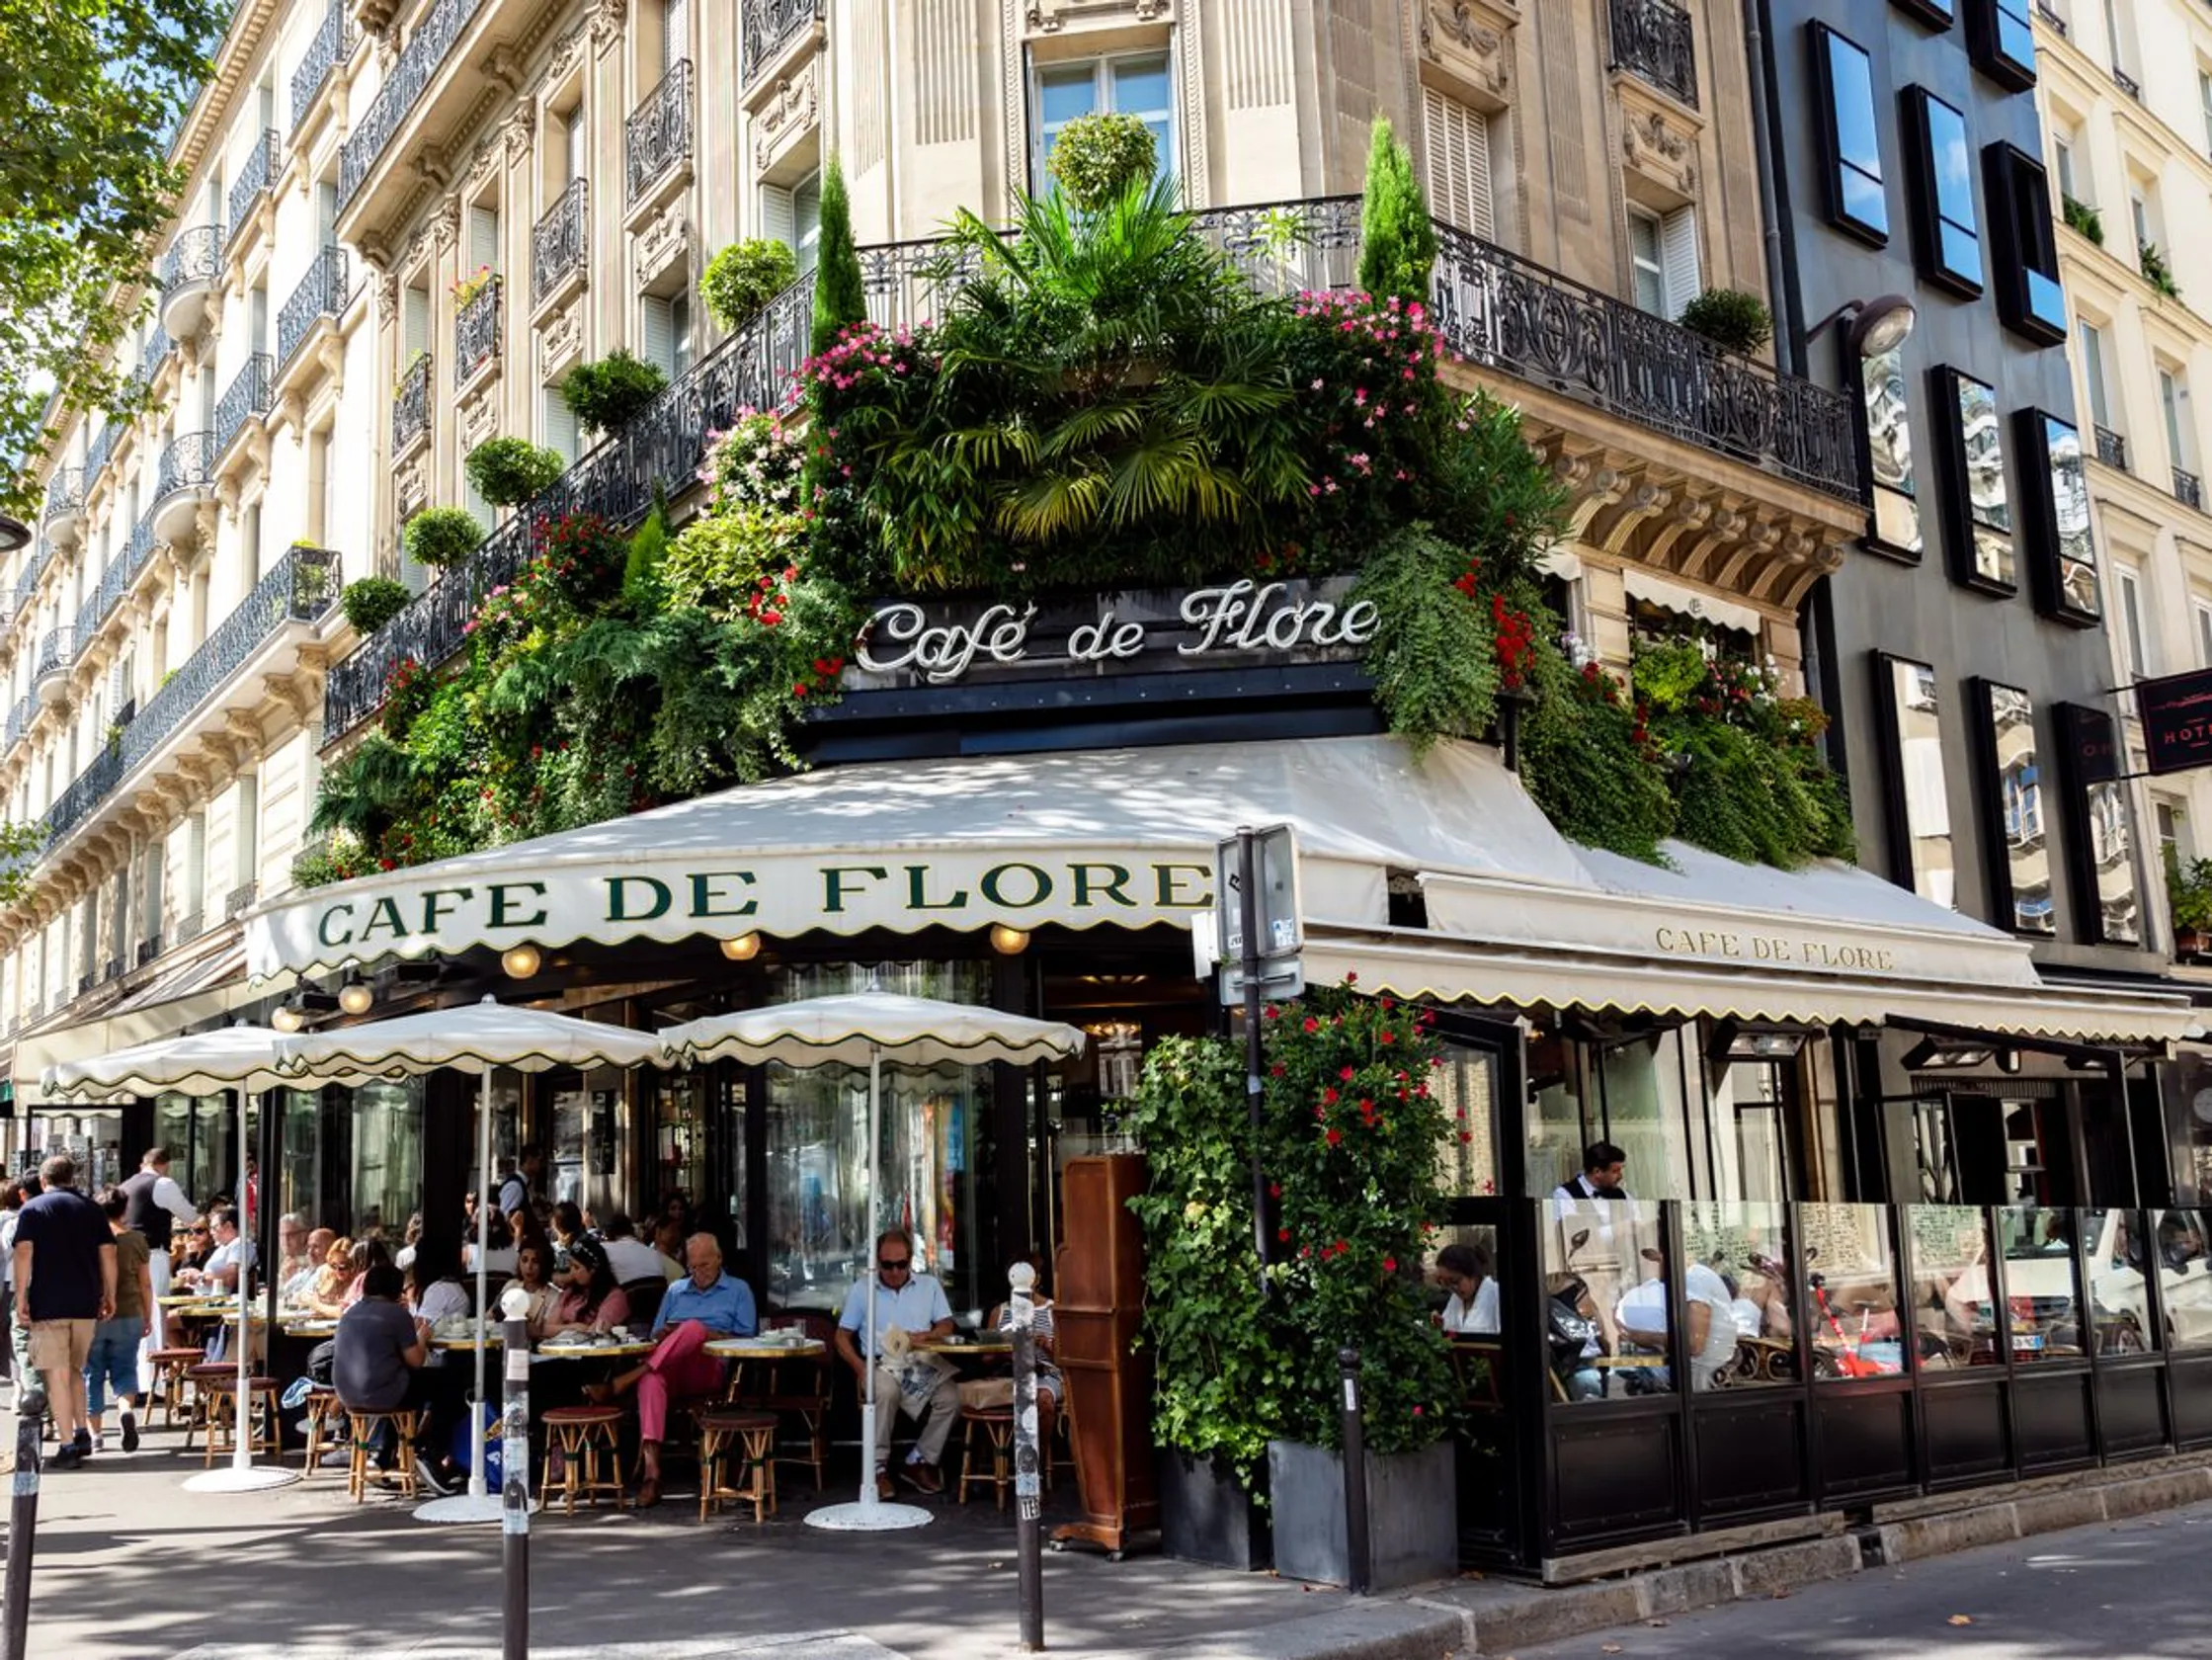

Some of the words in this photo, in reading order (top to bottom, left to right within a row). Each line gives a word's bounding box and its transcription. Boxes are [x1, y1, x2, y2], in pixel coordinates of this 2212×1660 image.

[856, 599, 1038, 684] Café
[1068, 611, 1145, 661] de
[1178, 579, 1382, 655] Flore
[317, 881, 547, 948] CAFE
[603, 871, 759, 922] DE
[818, 863, 1214, 913] FLORE
[1656, 927, 1740, 957] CAFE
[1752, 937, 1790, 960] DE
[1801, 942, 1893, 970] FLORE
